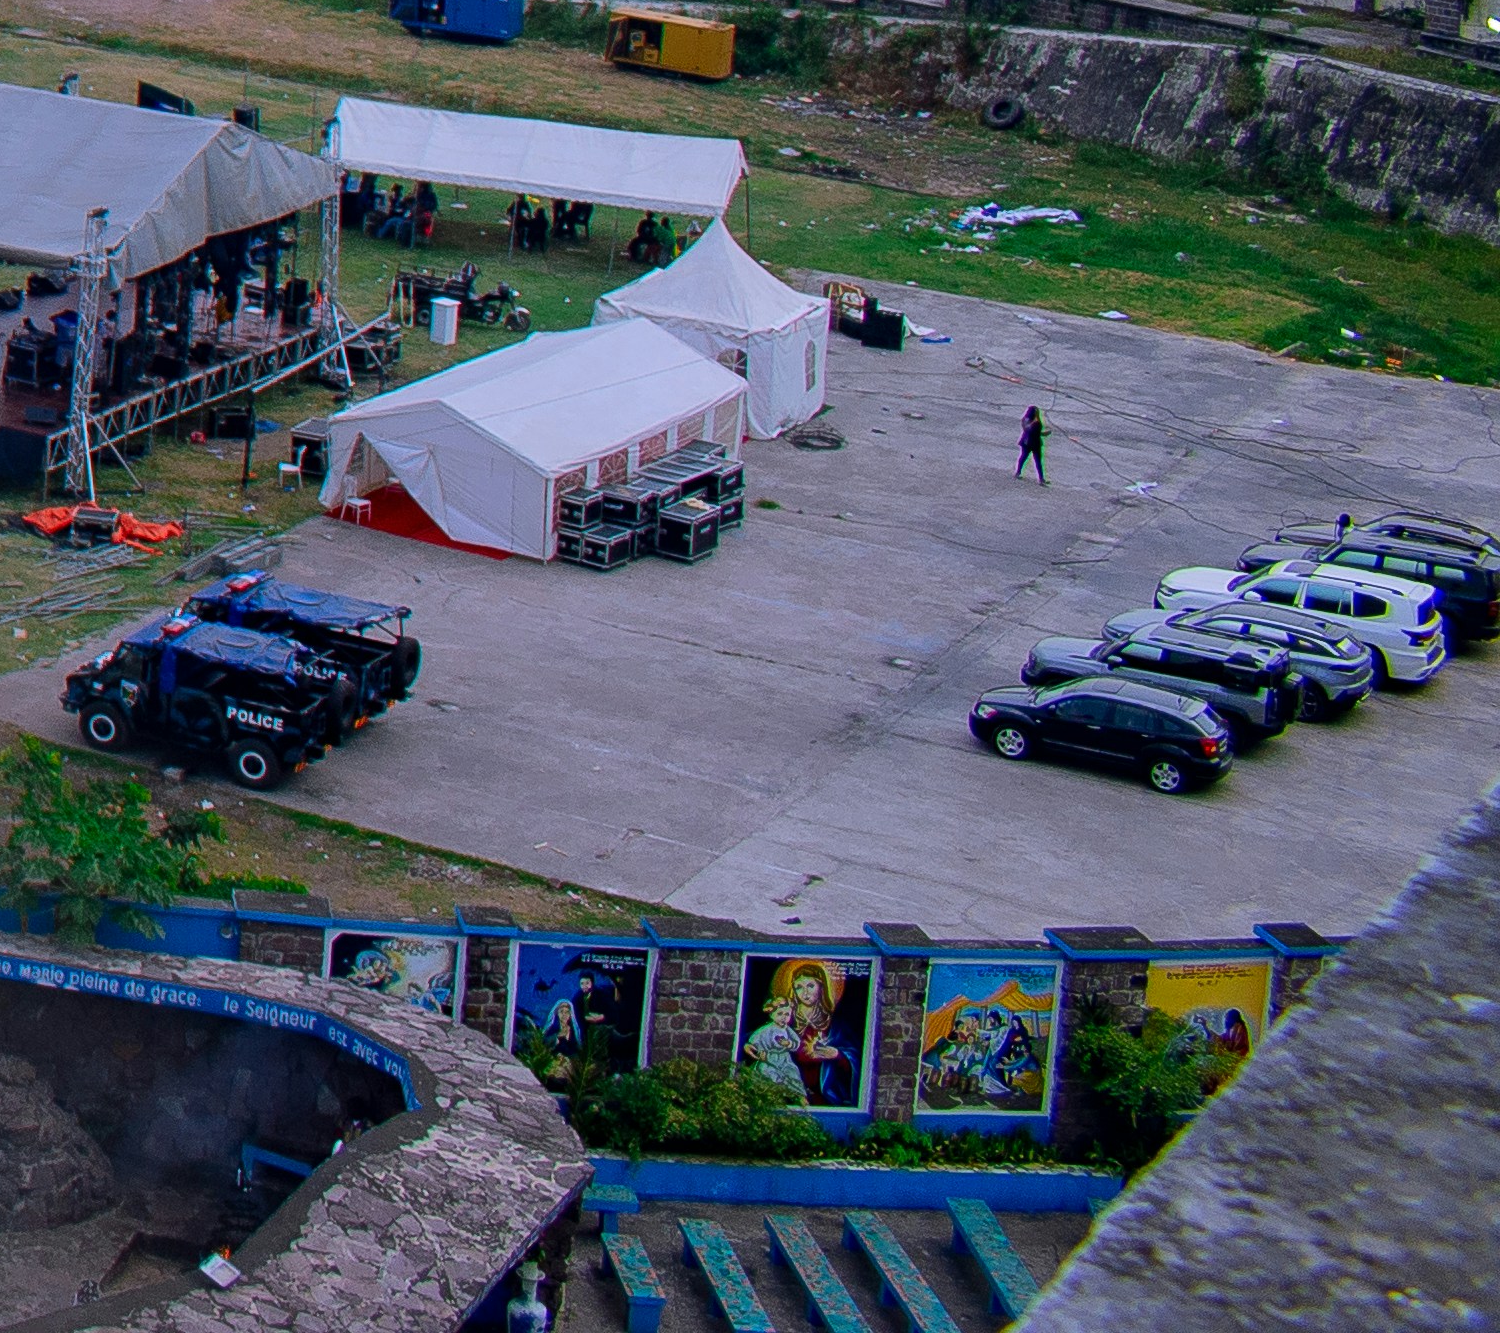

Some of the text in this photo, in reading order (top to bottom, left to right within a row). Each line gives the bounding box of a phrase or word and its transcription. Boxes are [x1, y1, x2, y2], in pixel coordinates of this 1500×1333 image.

[227, 706, 284, 732] POLICE
[124, 979, 145, 997] de
[223, 995, 239, 1013] le
[245, 1000, 317, 1029] Seigneur
[328, 1026, 348, 1047] est
[353, 1038, 380, 1065] avec
